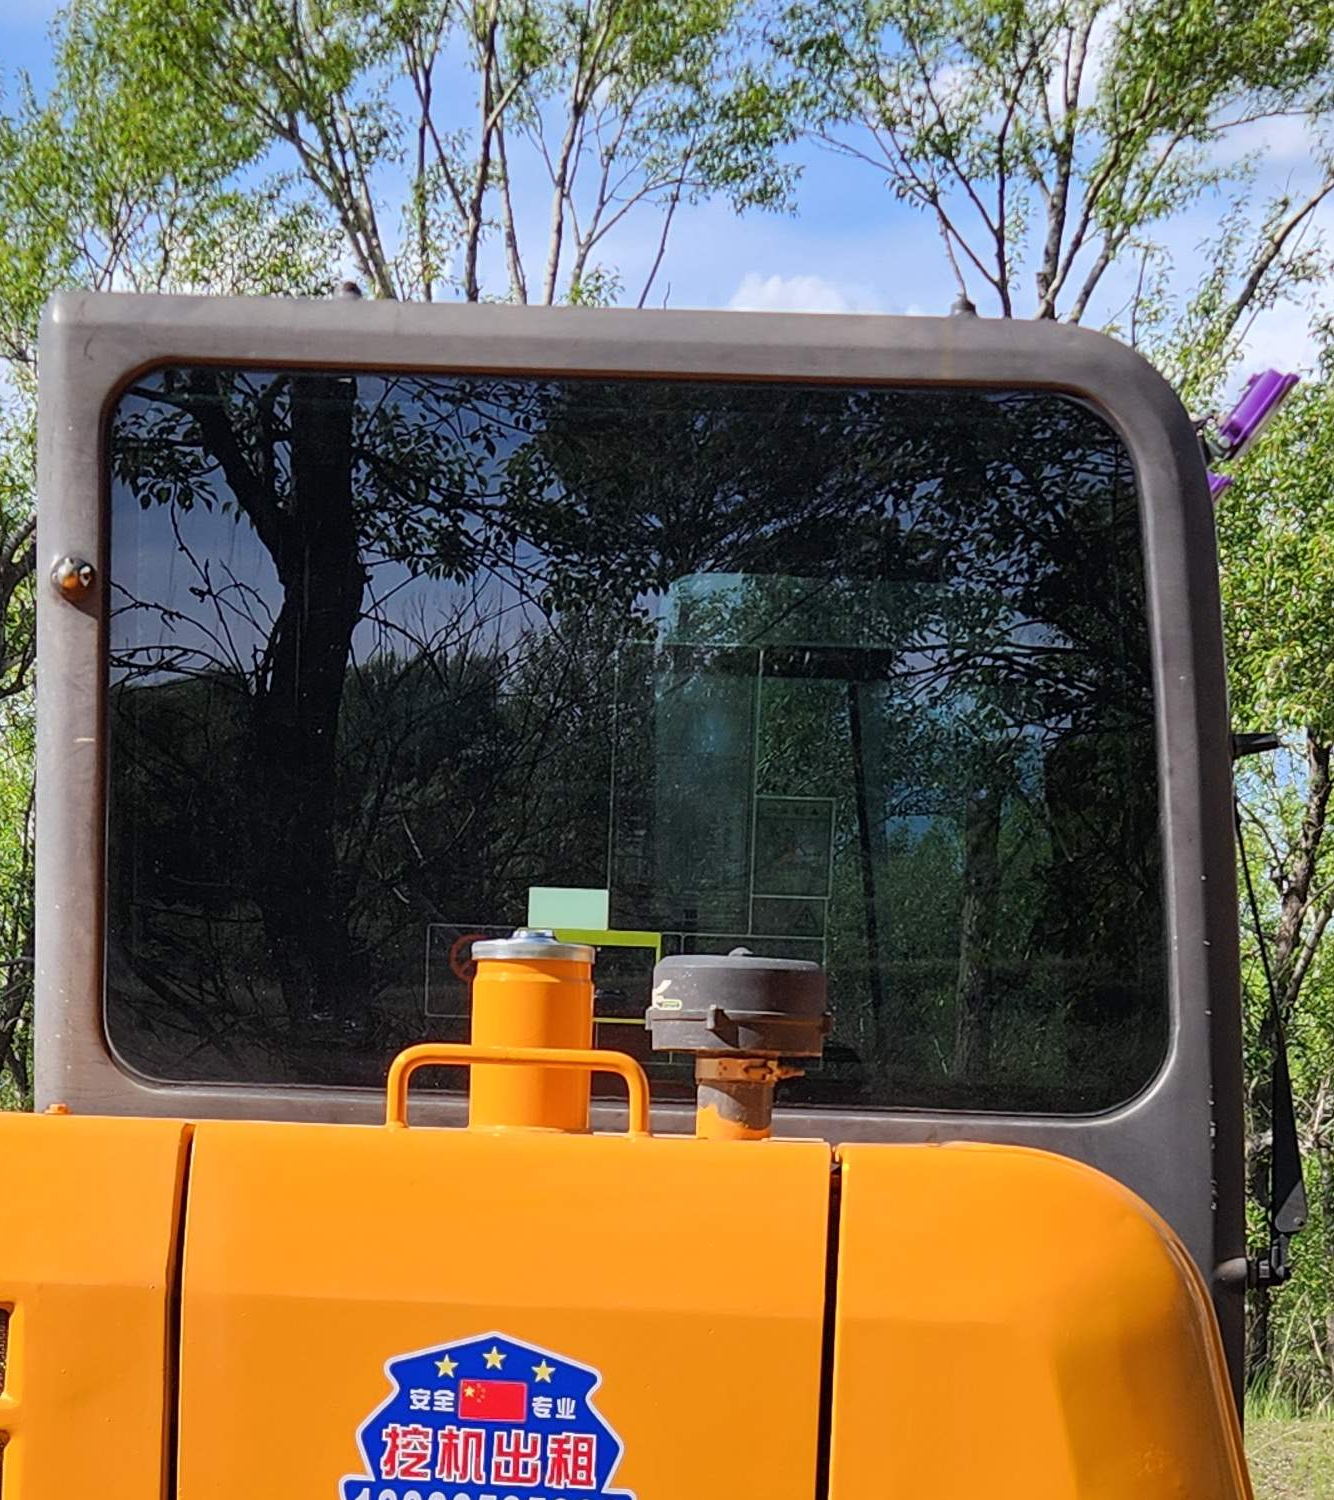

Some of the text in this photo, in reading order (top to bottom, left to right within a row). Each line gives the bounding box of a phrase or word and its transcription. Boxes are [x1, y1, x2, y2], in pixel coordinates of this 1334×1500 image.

[410, 1388, 576, 1420] 安全 专业
[380, 1424, 597, 1490] 挖机出租
